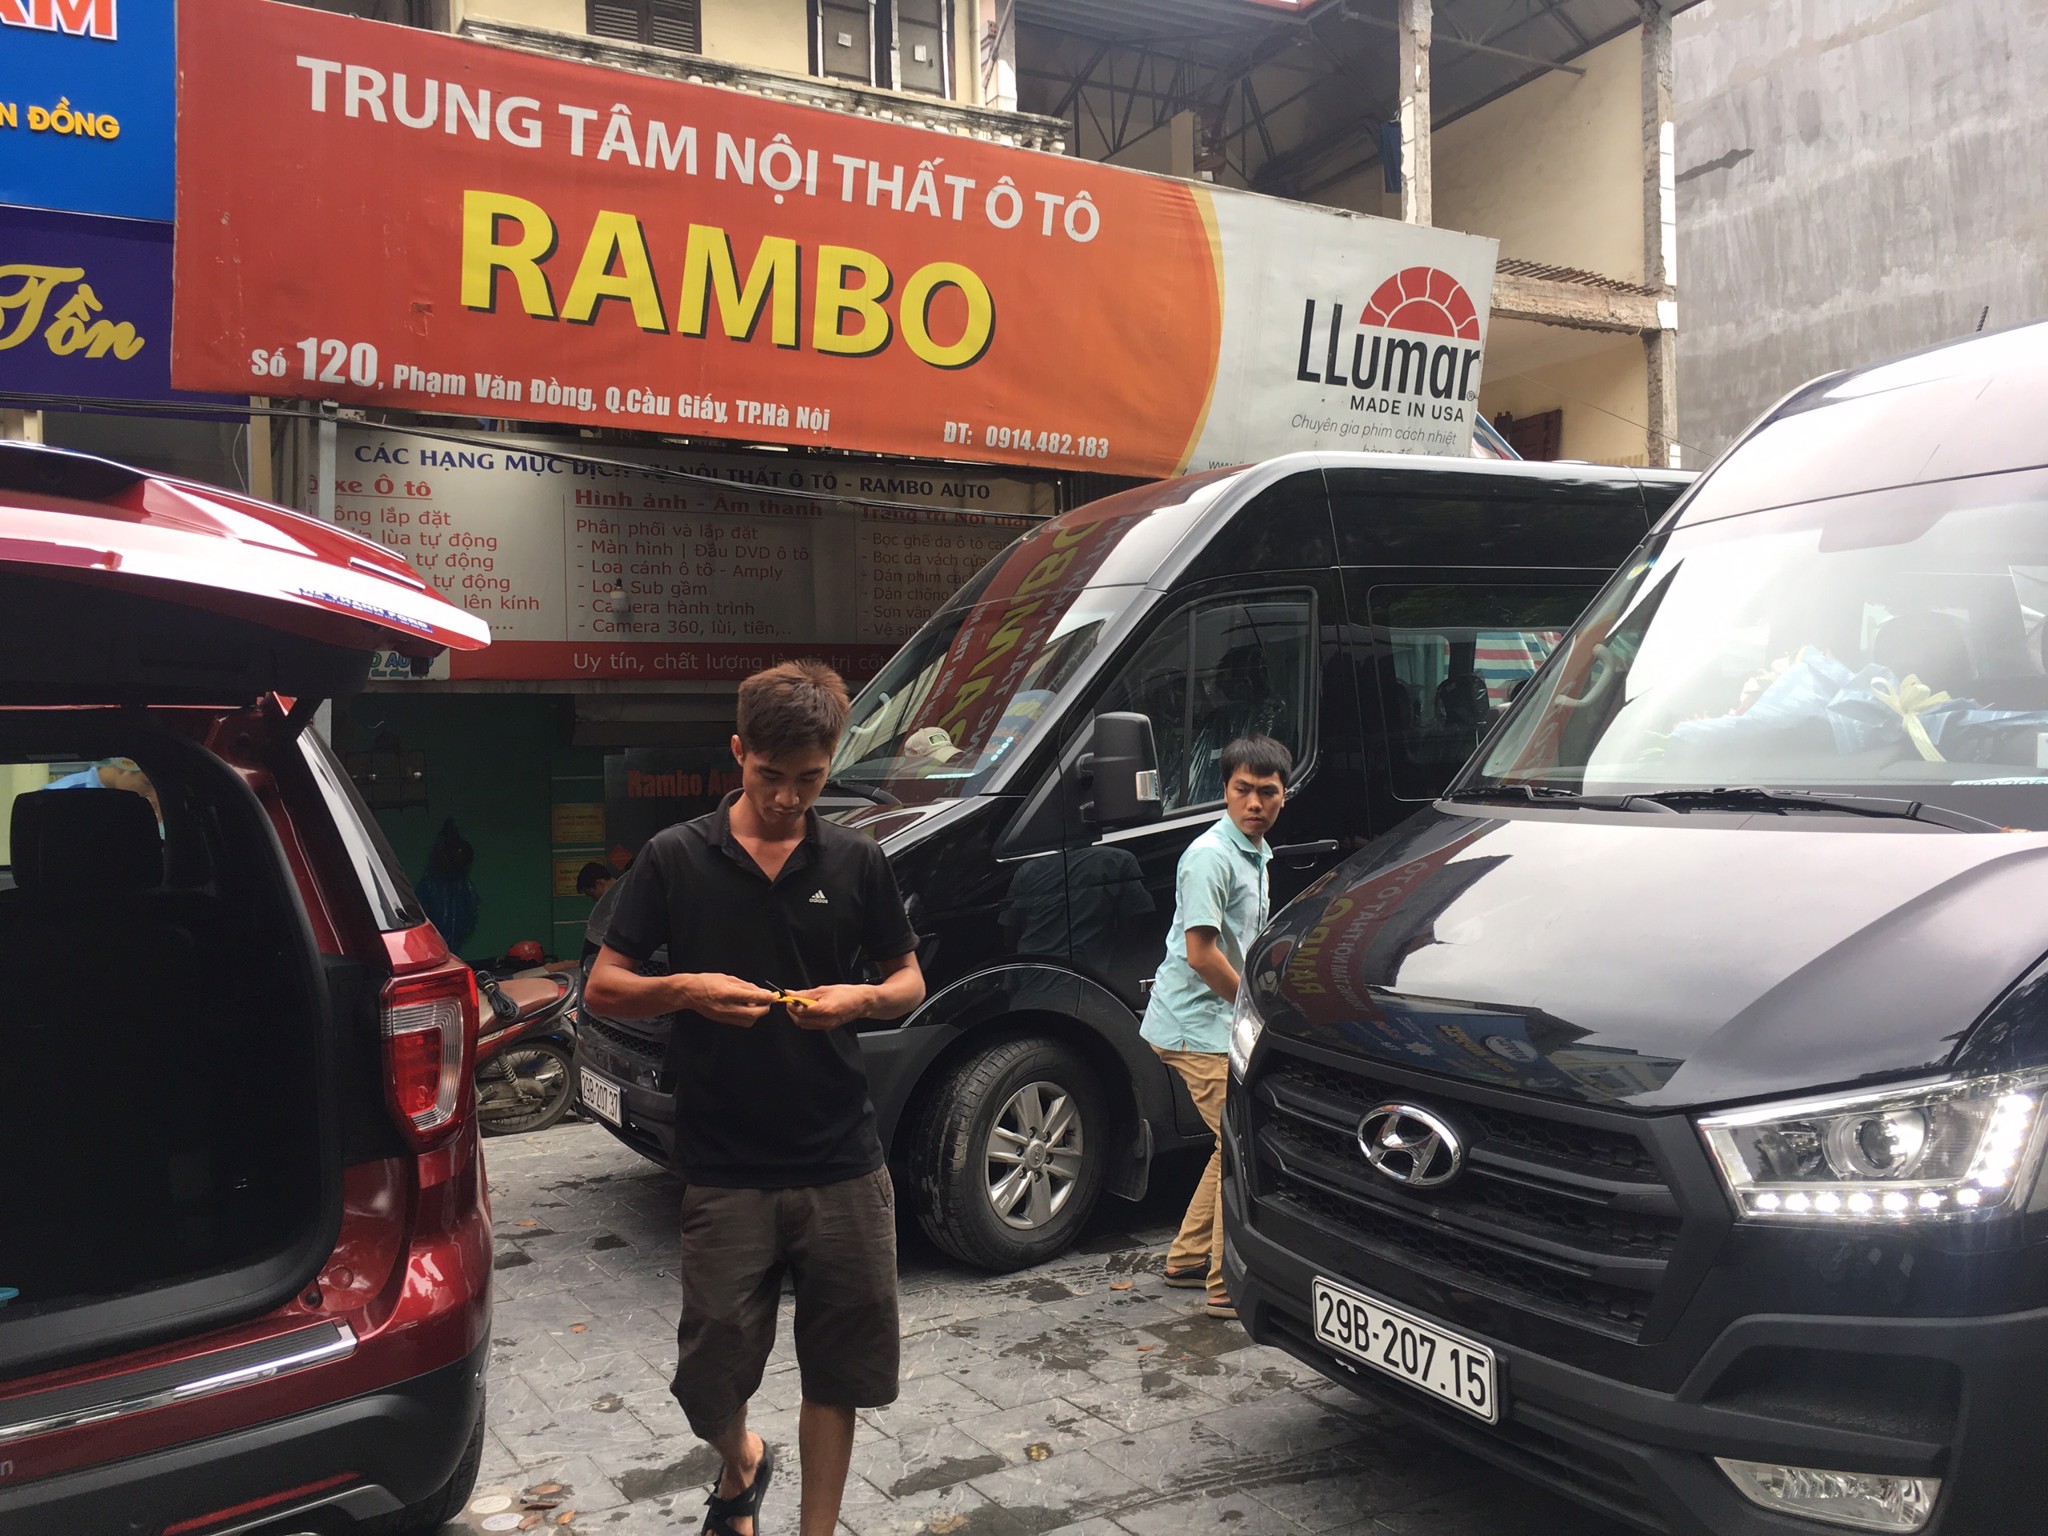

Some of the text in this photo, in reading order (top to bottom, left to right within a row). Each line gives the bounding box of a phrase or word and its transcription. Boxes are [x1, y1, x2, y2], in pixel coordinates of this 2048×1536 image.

[27, 96, 120, 140] ĐỒNG
[297, 55, 1102, 244] TRUNG TÂM NỘI THẤT Ô TÔ
[461, 190, 996, 369] RAMBO
[1296, 298, 1481, 402] LLumar
[250, 348, 287, 380] Số
[393, 364, 466, 401] Phạm
[474, 371, 522, 403] Văn
[529, 376, 597, 414] Đồng,
[604, 386, 671, 418] Q.Cầu
[677, 394, 729, 425] Giấy,
[736, 400, 790, 429] TP.Hà
[796, 405, 831, 432] Nội
[1350, 395, 1464, 423] MADE IN USA
[943, 421, 1110, 459] ĐT: 0914.482.183
[1291, 414, 1458, 446] Chuyên gia phim cách nhiệt
[355, 442, 410, 465] CÁC
[420, 449, 495, 472] HẠNG
[505, 454, 564, 478] MỤC
[726, 464, 783, 487] THẤT
[789, 466, 804, 488] Ô
[811, 470, 838, 490] TÔ
[860, 477, 934, 496] RAMBO
[941, 482, 991, 499] AUTO
[374, 473, 394, 495] Ô
[404, 481, 432, 497] tô
[575, 489, 823, 517] Hình ảnh Âm thanh
[335, 505, 452, 528] ông lắp đặt
[860, 505, 918, 524] Trang
[381, 530, 411, 545] lùa
[420, 531, 441, 549] tự
[448, 531, 498, 551] động
[576, 519, 759, 543] Phân phối và lắp đặt
[873, 533, 899, 546] Bọc
[904, 533, 931, 549] ghế
[935, 535, 951, 547] da
[956, 535, 965, 548] ô
[970, 537, 984, 549] tô
[592, 539, 810, 562] Màn hình Đầu DVD ô tô
[873, 551, 988, 568] Bọc da vách cửa
[416, 552, 494, 572] tự động
[592, 560, 784, 581] Loa cánh ô tô Amply
[432, 573, 511, 593] tự động
[873, 569, 902, 582] Dán
[907, 570, 941, 585] phim
[630, 581, 664, 595] Sub
[671, 581, 708, 599] gầm
[873, 587, 902, 600] Dán
[463, 594, 540, 610] lên kính
[667, 600, 710, 616] hành
[716, 601, 755, 617] trình
[873, 606, 901, 618] Sơn
[592, 619, 661, 634] Camera
[667, 620, 704, 637] 360,
[874, 624, 893, 639] Vệ
[385, 652, 435, 668] AU
[573, 652, 602, 673] Uy
[609, 653, 645, 672] tín,
[653, 652, 699, 671] chất
[706, 653, 763, 674] lượng
[628, 769, 703, 799] Rambo
[1319, 1291, 1487, 1407] 29B-207.15
